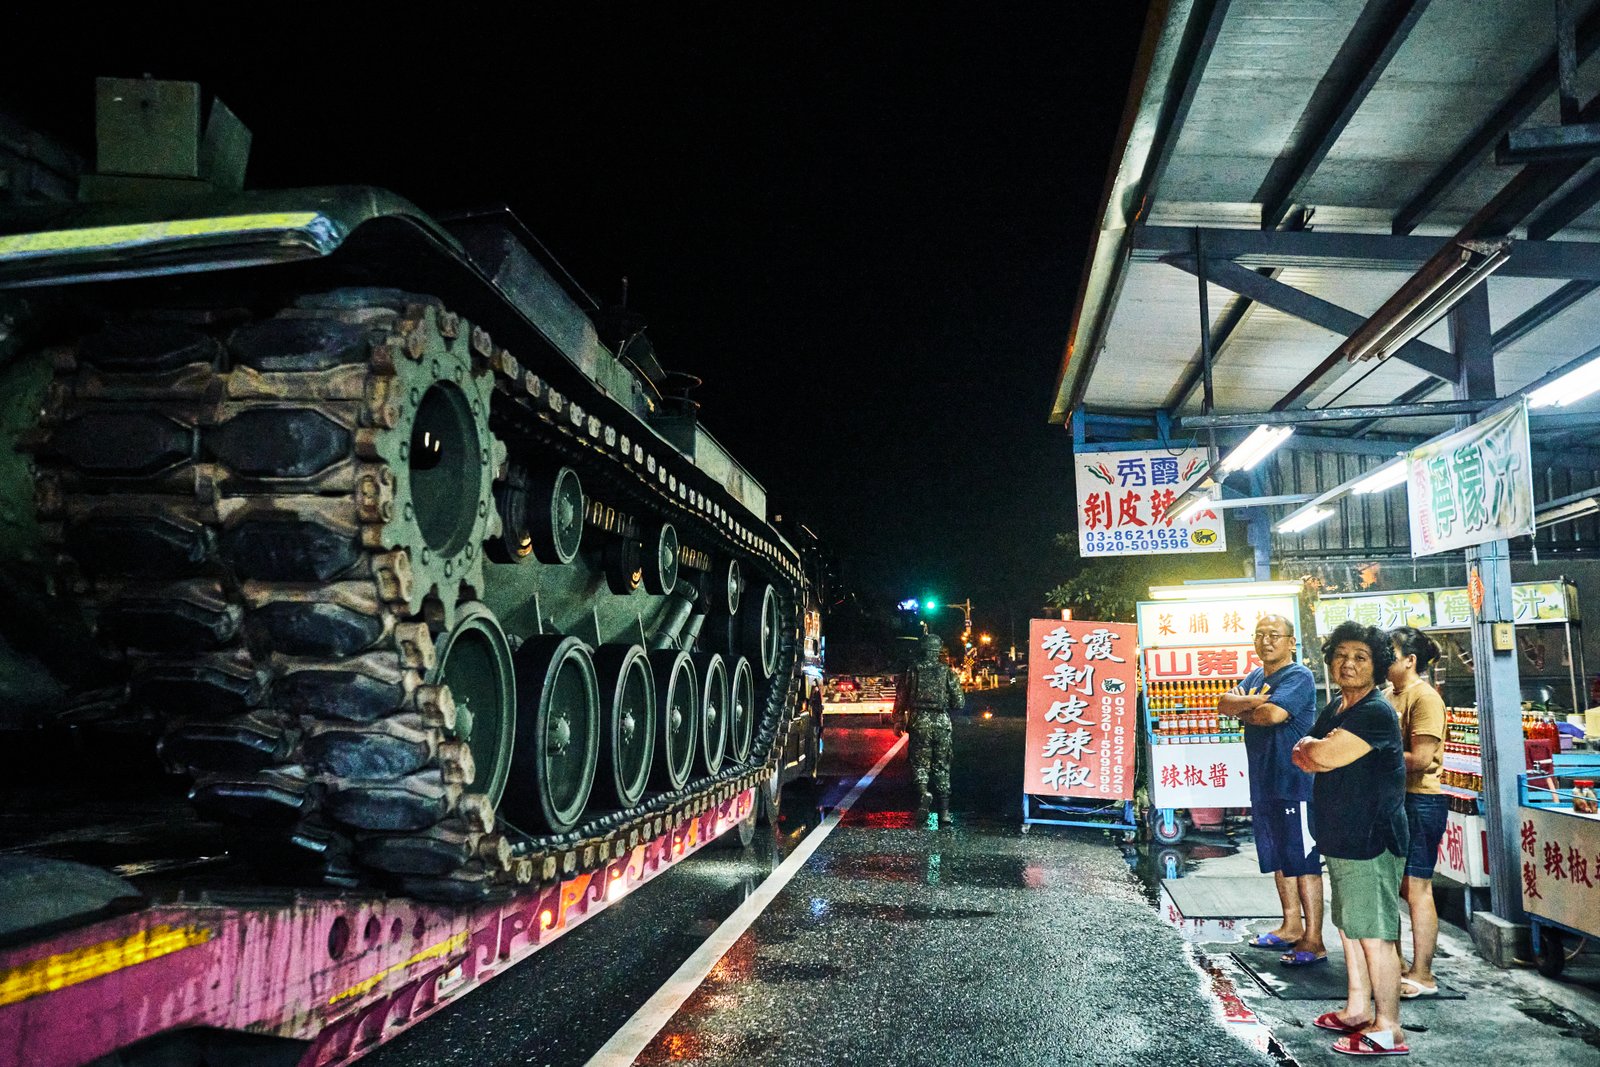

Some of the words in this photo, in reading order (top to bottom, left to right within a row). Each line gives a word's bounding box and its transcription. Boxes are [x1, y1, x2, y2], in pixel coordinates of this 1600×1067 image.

[1117, 456, 1179, 487] 秀霞
[1086, 528, 1189, 542] 03-8621623
[1086, 539, 1189, 552] 0920-509596
[1158, 610, 1268, 635] 菜脯辣
[1323, 599, 1413, 631] 檸檬汁
[1041, 626, 1126, 663] 秀霞
[1100, 696, 1112, 793] 0920-509596
[1113, 697, 1125, 793] 03-8621623
[1521, 820, 1542, 899] 特製
[1544, 841, 1600, 888] 辣椒
